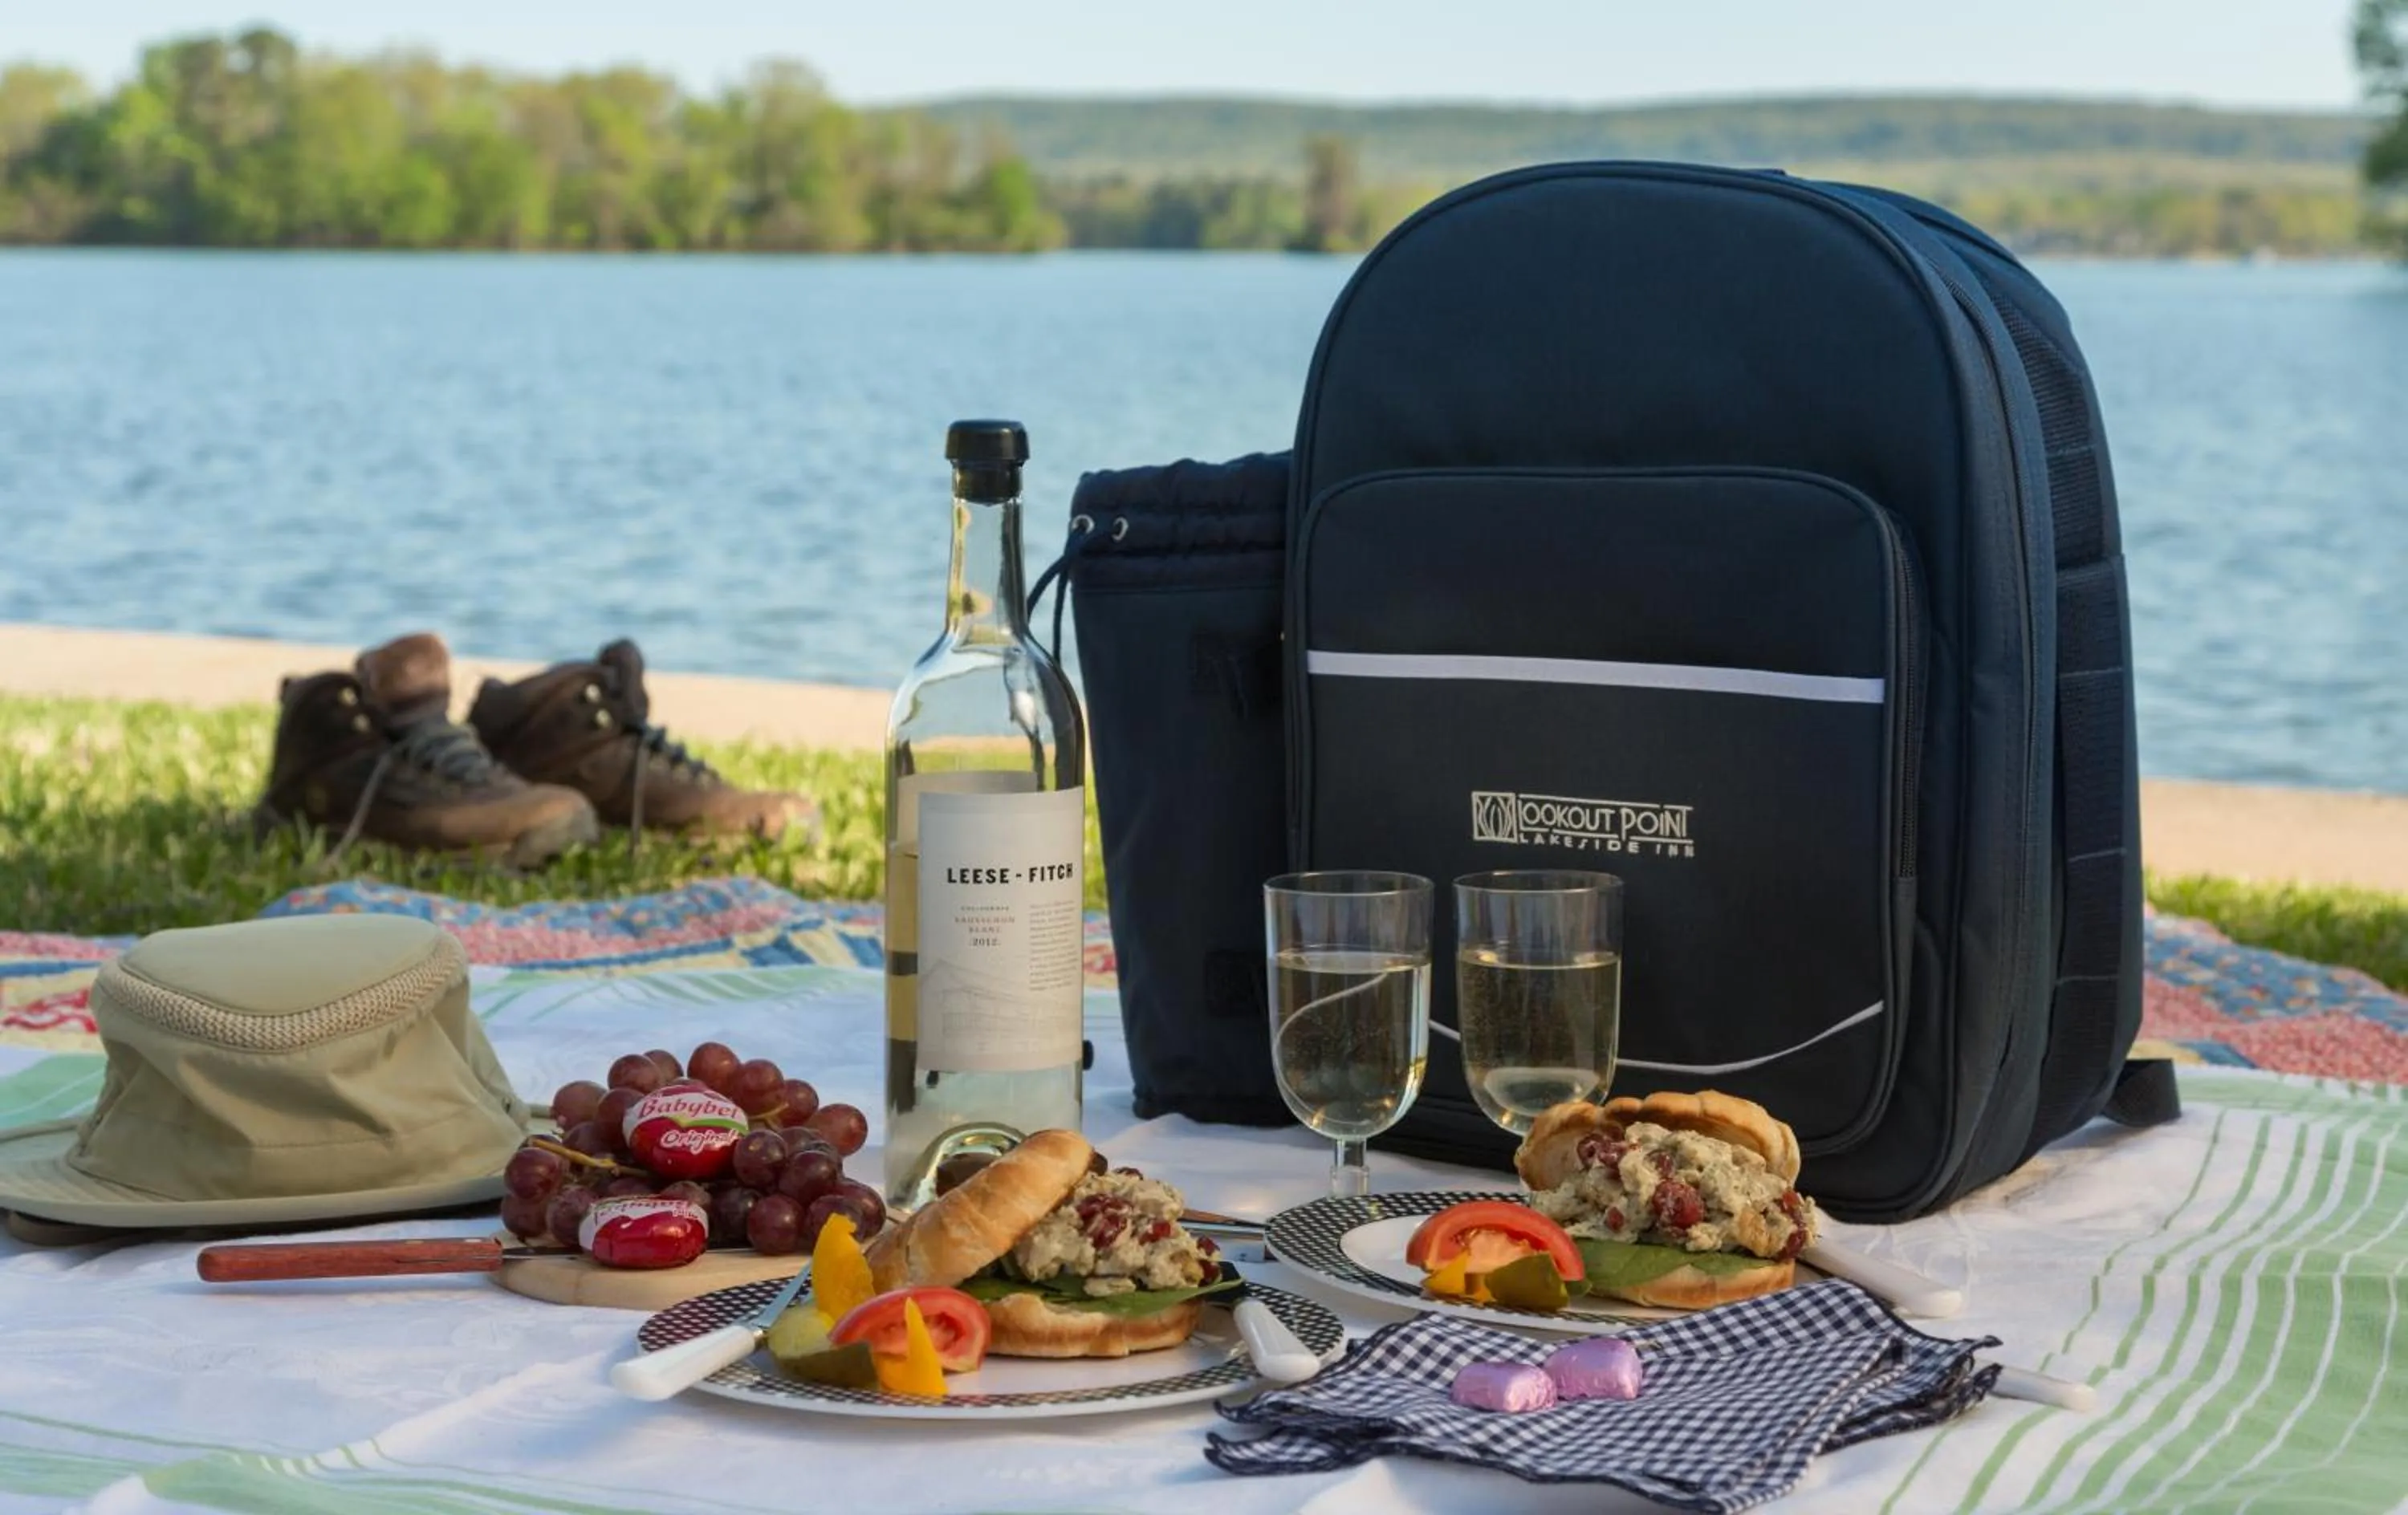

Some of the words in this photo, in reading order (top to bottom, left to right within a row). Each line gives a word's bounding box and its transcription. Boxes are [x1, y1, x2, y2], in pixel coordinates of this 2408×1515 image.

[1518, 799, 1615, 832] LOOKOUT
[1620, 804, 1693, 840] POINT
[1519, 835, 1640, 854] LAKESIDE
[947, 867, 1010, 883] LEESE
[1029, 863, 1073, 883] FITCH
[639, 1098, 738, 1119] Babybel
